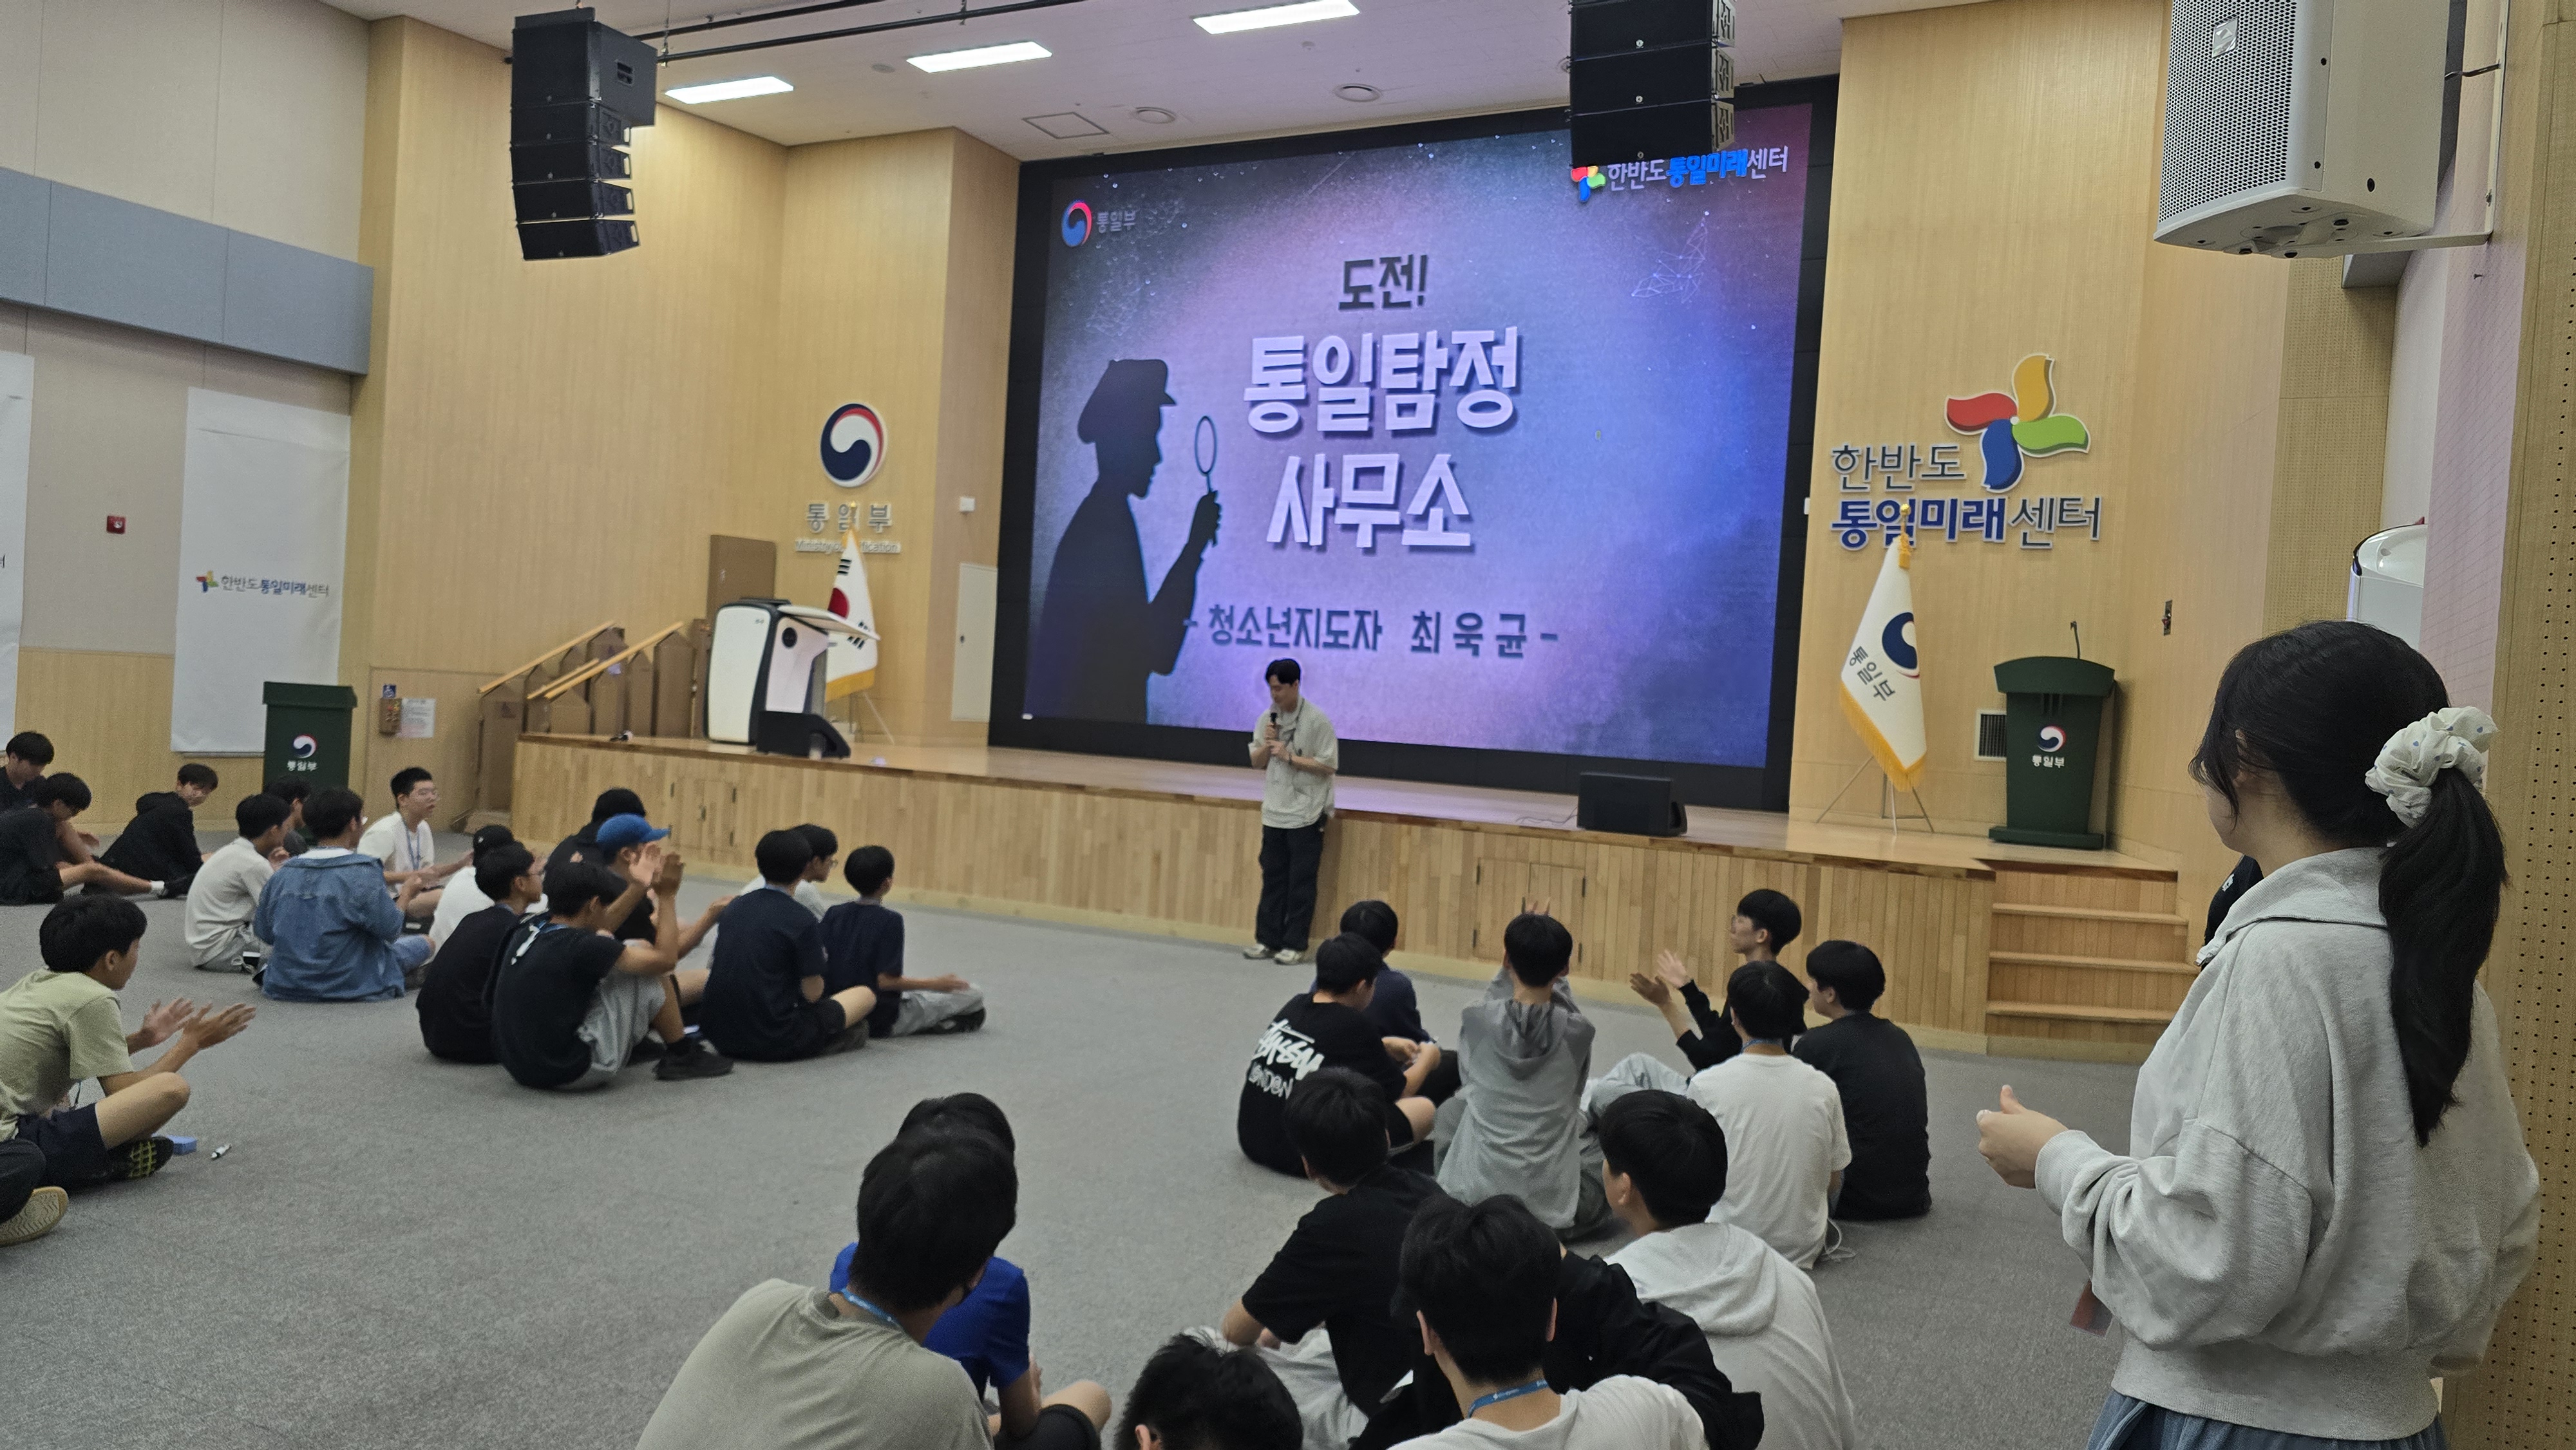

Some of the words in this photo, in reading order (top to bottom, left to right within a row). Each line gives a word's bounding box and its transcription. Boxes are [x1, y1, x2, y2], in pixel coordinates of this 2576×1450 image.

[1607, 146, 1788, 192] 한반도통일미래센터
[1096, 209, 1136, 234] 통일부
[1338, 254, 1428, 311] 도전!
[1244, 326, 1519, 433] 통일탐정
[1831, 444, 1966, 493] 한반도
[1266, 453, 1471, 549] 사무소
[1830, 496, 2102, 551] 통일미래센터
[220, 575, 329, 598] 한반도통일미래센터
[1208, 604, 1383, 651] 청소년지도자
[1848, 645, 1896, 702] 통일부
[2031, 754, 2065, 769] 통일부
